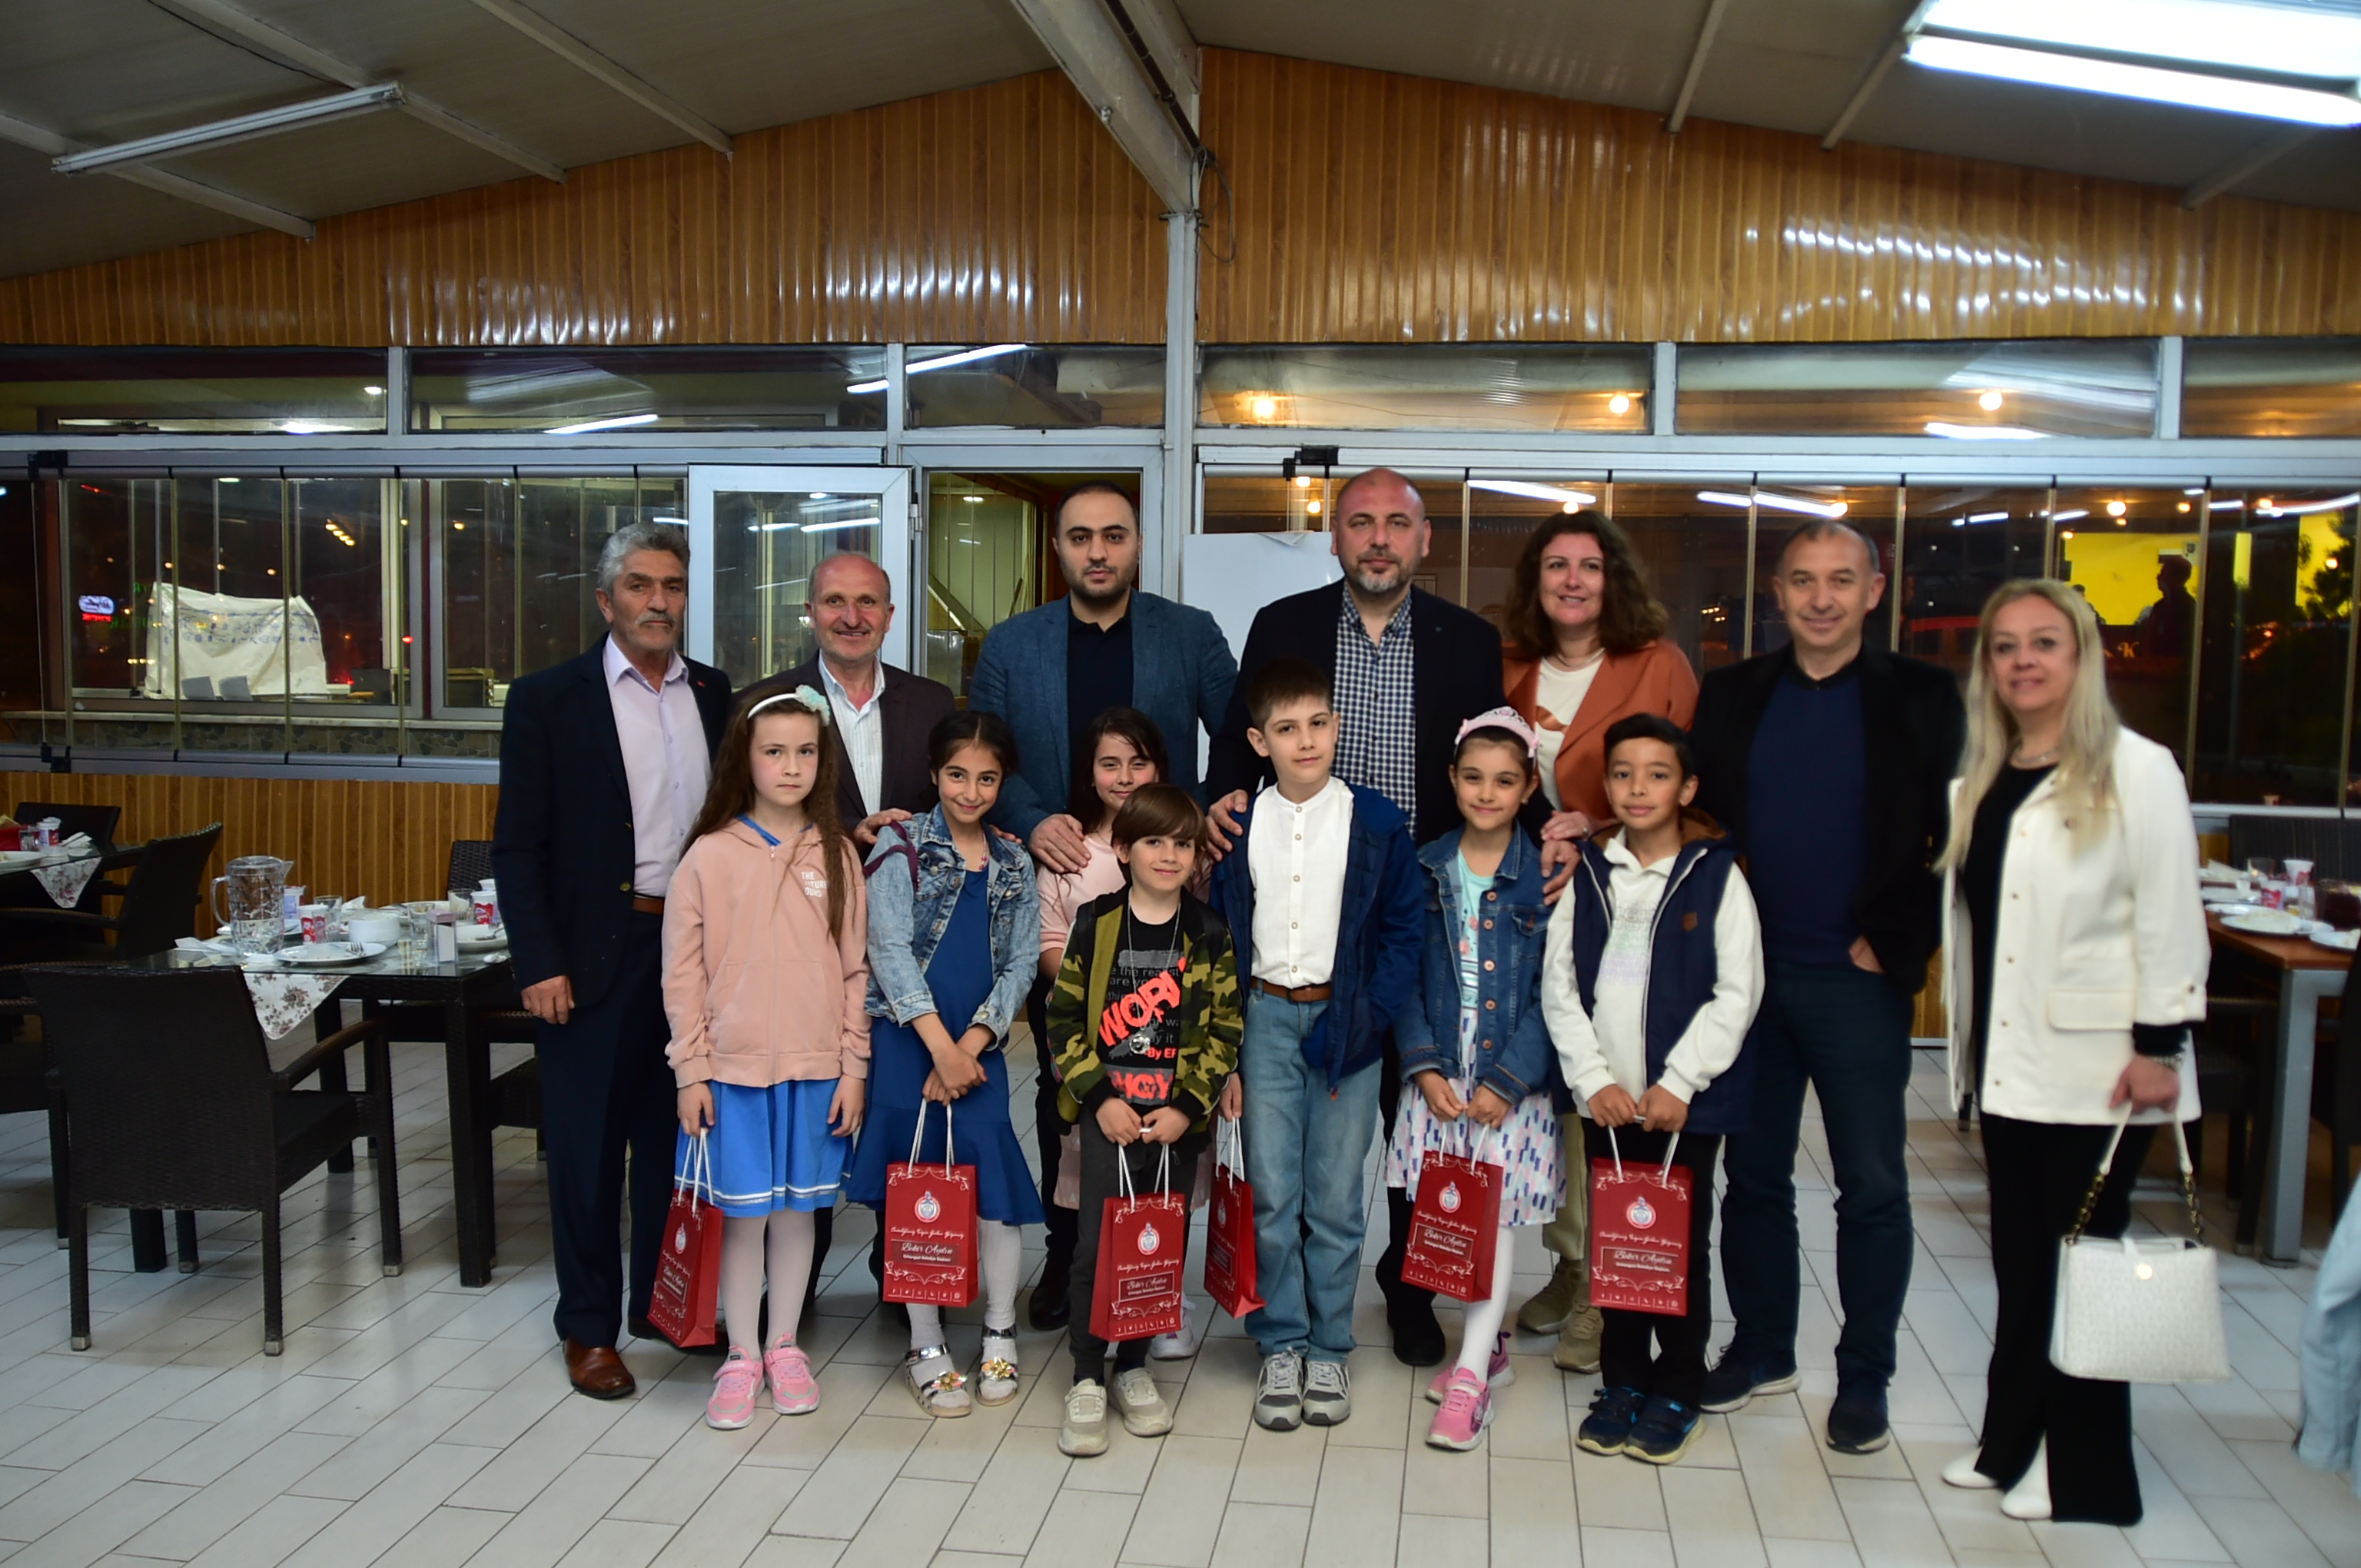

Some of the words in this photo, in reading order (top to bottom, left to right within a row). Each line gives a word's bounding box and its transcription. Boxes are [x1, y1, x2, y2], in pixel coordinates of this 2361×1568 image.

[801, 871, 815, 880] THE
[804, 886, 822, 898] OURS
[1121, 968, 1138, 977] the
[1110, 977, 1130, 986] are
